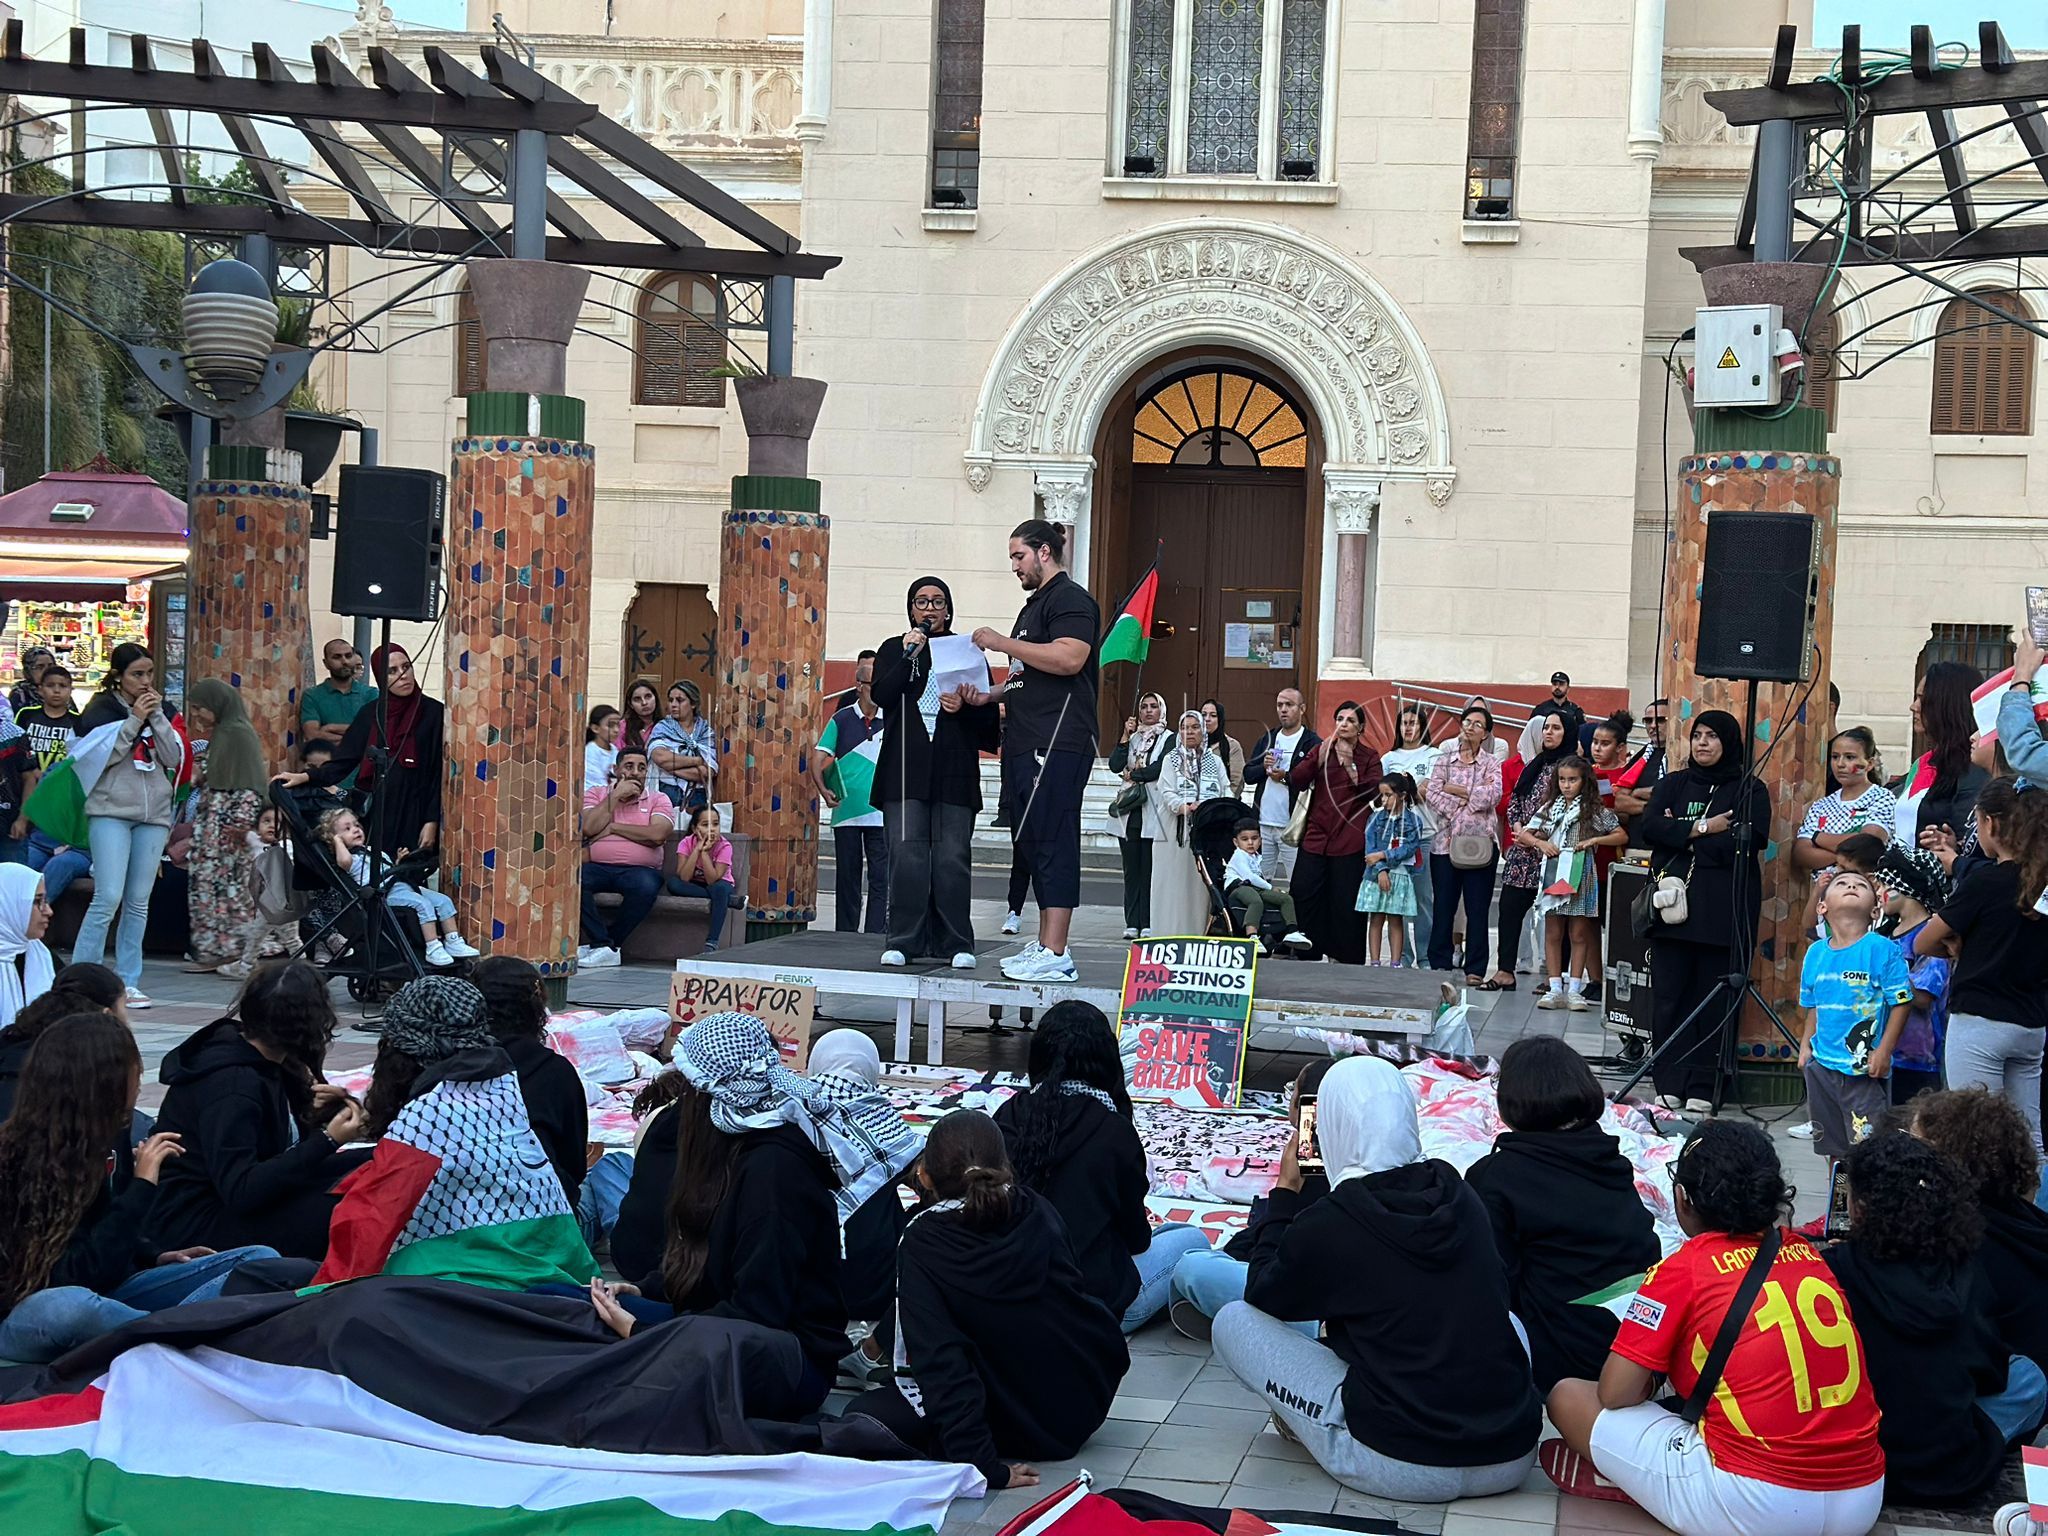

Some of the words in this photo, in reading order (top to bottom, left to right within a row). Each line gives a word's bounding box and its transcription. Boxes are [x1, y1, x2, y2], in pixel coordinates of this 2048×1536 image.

[428, 579, 437, 619] DEXFIRE
[1139, 941, 1179, 965] LOS
[1183, 940, 1247, 969] NIÑOS
[683, 977, 749, 1010] PRAY
[755, 985, 802, 1017] FOR
[1134, 969, 1246, 989] PALESTINOS
[1135, 989, 1240, 1009] IMPORTAN!
[1136, 1028, 1211, 1065] SAVE
[1754, 1275, 1861, 1414] 19
